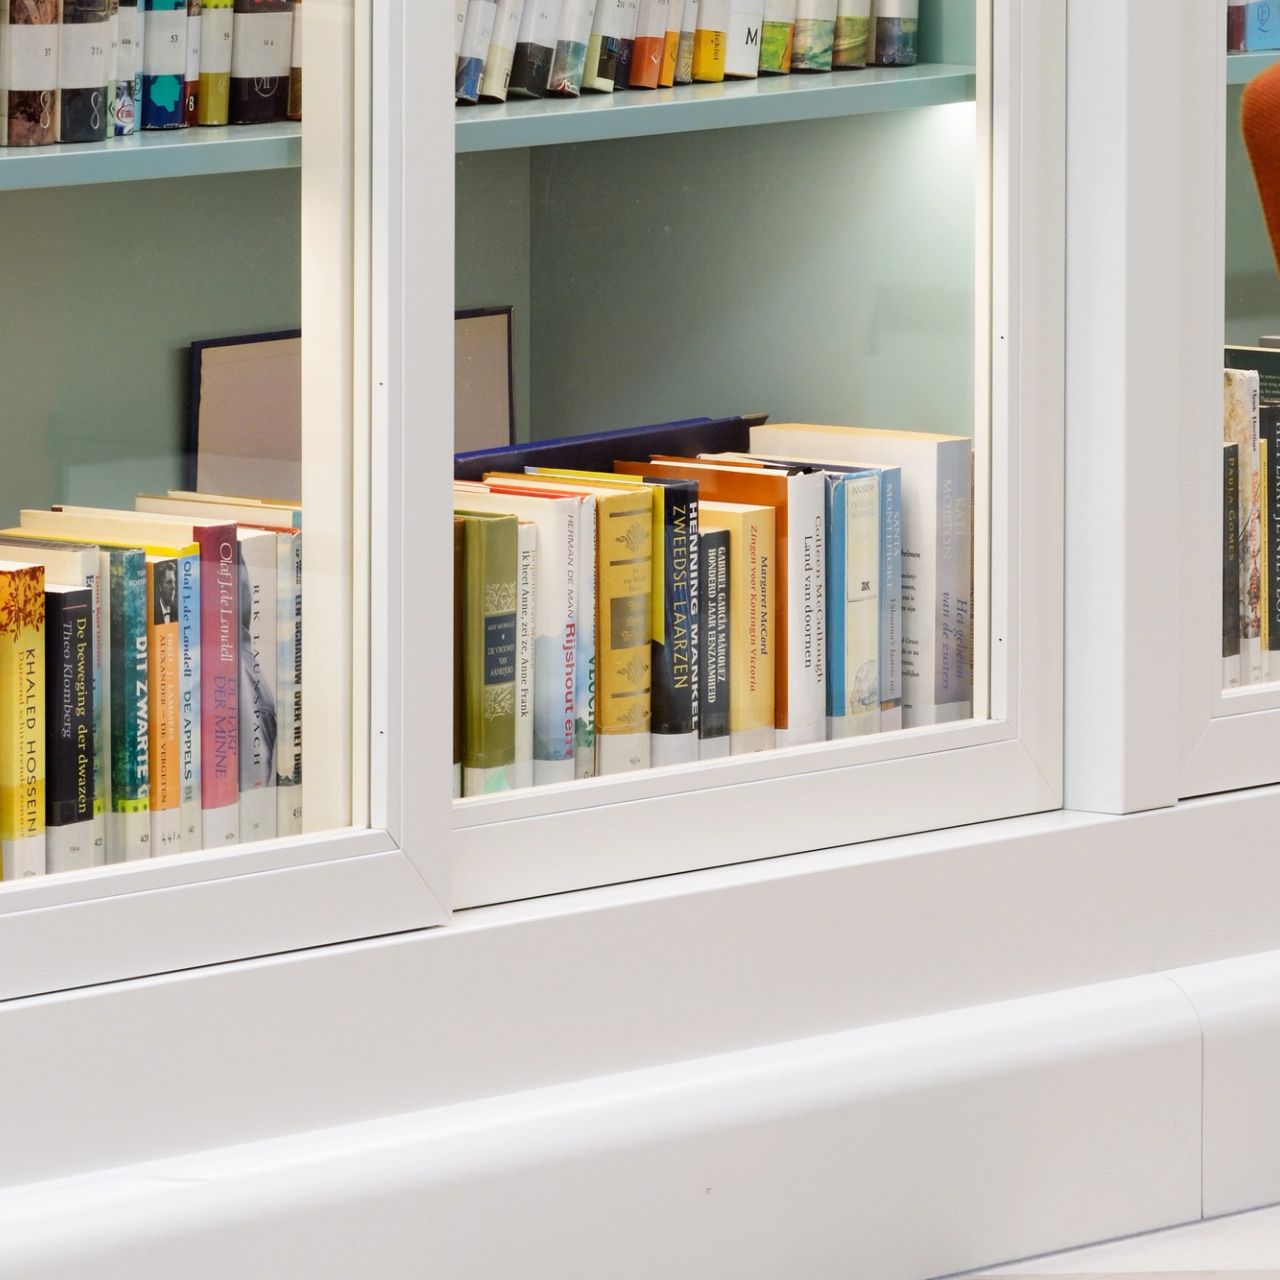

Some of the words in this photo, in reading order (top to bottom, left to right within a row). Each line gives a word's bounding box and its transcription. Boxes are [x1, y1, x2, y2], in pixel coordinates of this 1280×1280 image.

[170, 34, 179, 43] 53
[745, 27, 758, 46] M
[1227, 457, 1235, 505] PAULA
[567, 514, 575, 566] HERMAN
[672, 505, 687, 591] ZWEEDSE
[748, 525, 758, 564] Zingen
[804, 535, 814, 572] Land
[1227, 510, 1235, 561] GOMES
[217, 542, 233, 575] Olaf
[521, 549, 530, 561] Ik
[708, 548, 717, 598] HONDERD
[181, 561, 192, 590] Olaf
[216, 578, 232, 592] J.
[521, 563, 530, 586] heet
[567, 569, 575, 585] DE
[760, 556, 769, 609] Margaret
[181, 593, 192, 604] J.
[182, 605, 192, 622] de
[220, 591, 232, 607] de
[519, 588, 530, 620] Anne,
[567, 588, 575, 618] MAN
[707, 600, 717, 628] JAAR
[942, 592, 950, 619] van
[76, 618, 87, 639] De
[220, 608, 233, 661] Landell
[521, 622, 530, 637] zei
[748, 593, 758, 645] Koningin
[760, 611, 769, 655] McCord
[804, 605, 814, 669] doornen
[942, 623, 951, 639] de
[62, 621, 73, 659] Theo
[135, 635, 148, 672] DIT
[183, 625, 192, 677] Landell
[519, 640, 529, 655] ze,
[673, 601, 688, 689] LAARZEN
[73, 642, 88, 716] beweging
[520, 657, 530, 686] Anne
[562, 623, 577, 715] Rijshout
[707, 630, 717, 703] EENZAAMHEID
[749, 648, 758, 692] Victoria
[942, 643, 951, 689] zusters
[25, 648, 37, 729] KHALED
[61, 663, 73, 740] Klomberg
[183, 691, 192, 715] DE
[214, 675, 227, 708] DER
[252, 635, 261, 767] LAUNSPACH
[520, 688, 529, 718] Frank
[78, 724, 88, 749] der
[135, 678, 149, 780] ZWARTE
[215, 714, 228, 780] MINNE
[564, 718, 575, 745] en
[183, 718, 192, 781] APPELS
[78, 751, 89, 814] dwazen
